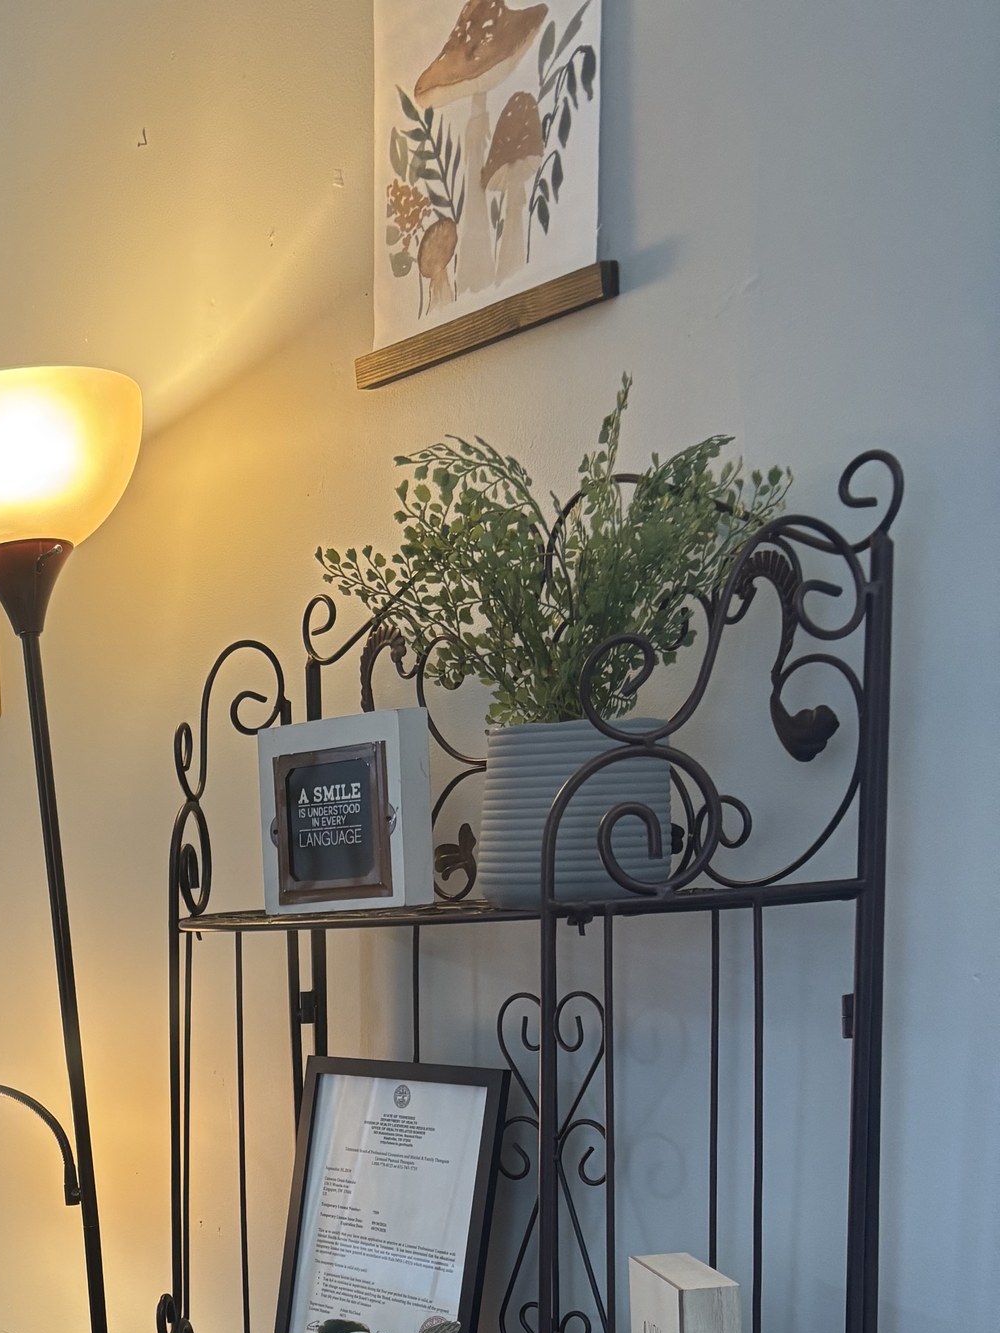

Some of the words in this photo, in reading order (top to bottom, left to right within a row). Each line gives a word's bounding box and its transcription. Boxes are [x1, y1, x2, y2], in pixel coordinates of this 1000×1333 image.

[298, 787, 309, 804] A
[313, 783, 361, 802] SMILE
[299, 808, 306, 818] IS
[307, 803, 360, 817] UNDERSTOOD
[312, 817, 320, 827] IN
[321, 815, 346, 827] EVERY
[299, 828, 362, 848] LANGUAGE
